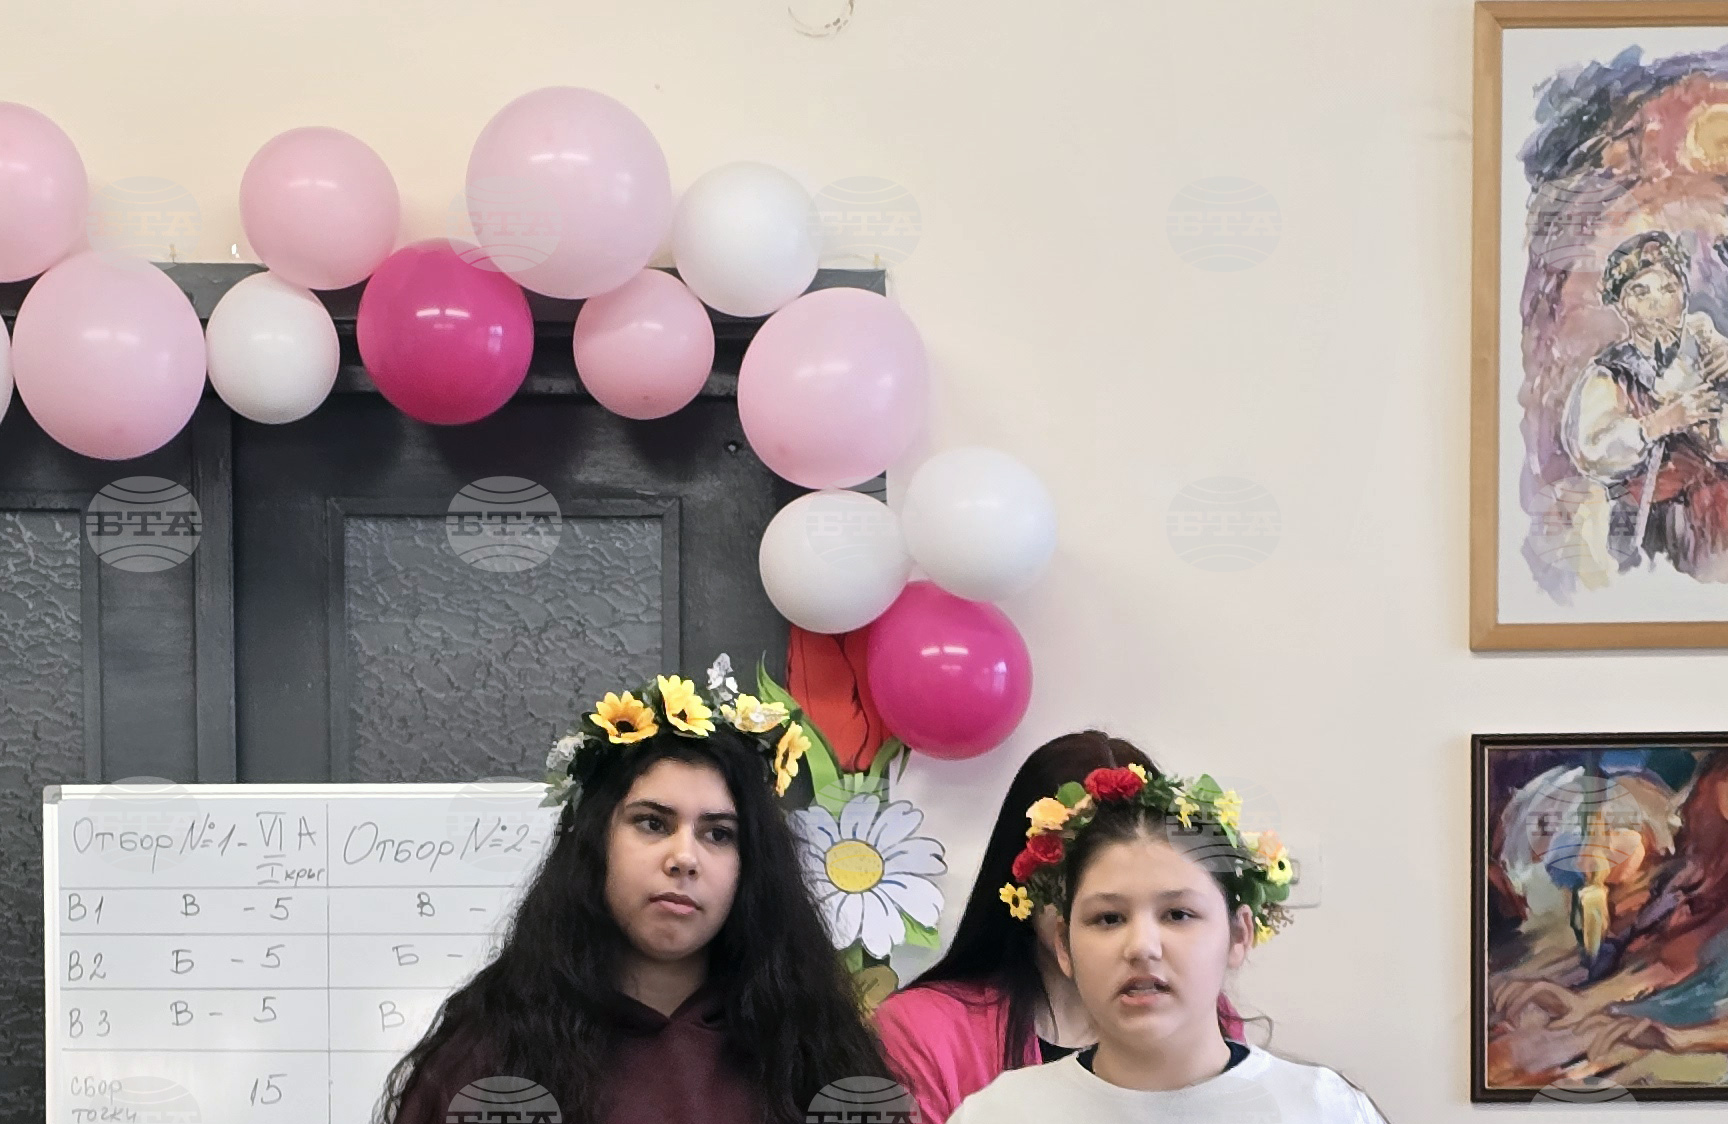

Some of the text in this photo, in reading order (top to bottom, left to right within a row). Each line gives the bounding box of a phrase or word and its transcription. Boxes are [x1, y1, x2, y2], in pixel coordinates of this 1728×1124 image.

[74, 817, 173, 873] Отбор
[344, 822, 453, 872] Отбор
[270, 897, 293, 920] 5
[261, 944, 285, 968] 5
[253, 996, 277, 1023] 5
[250, 1074, 287, 1106] 15
